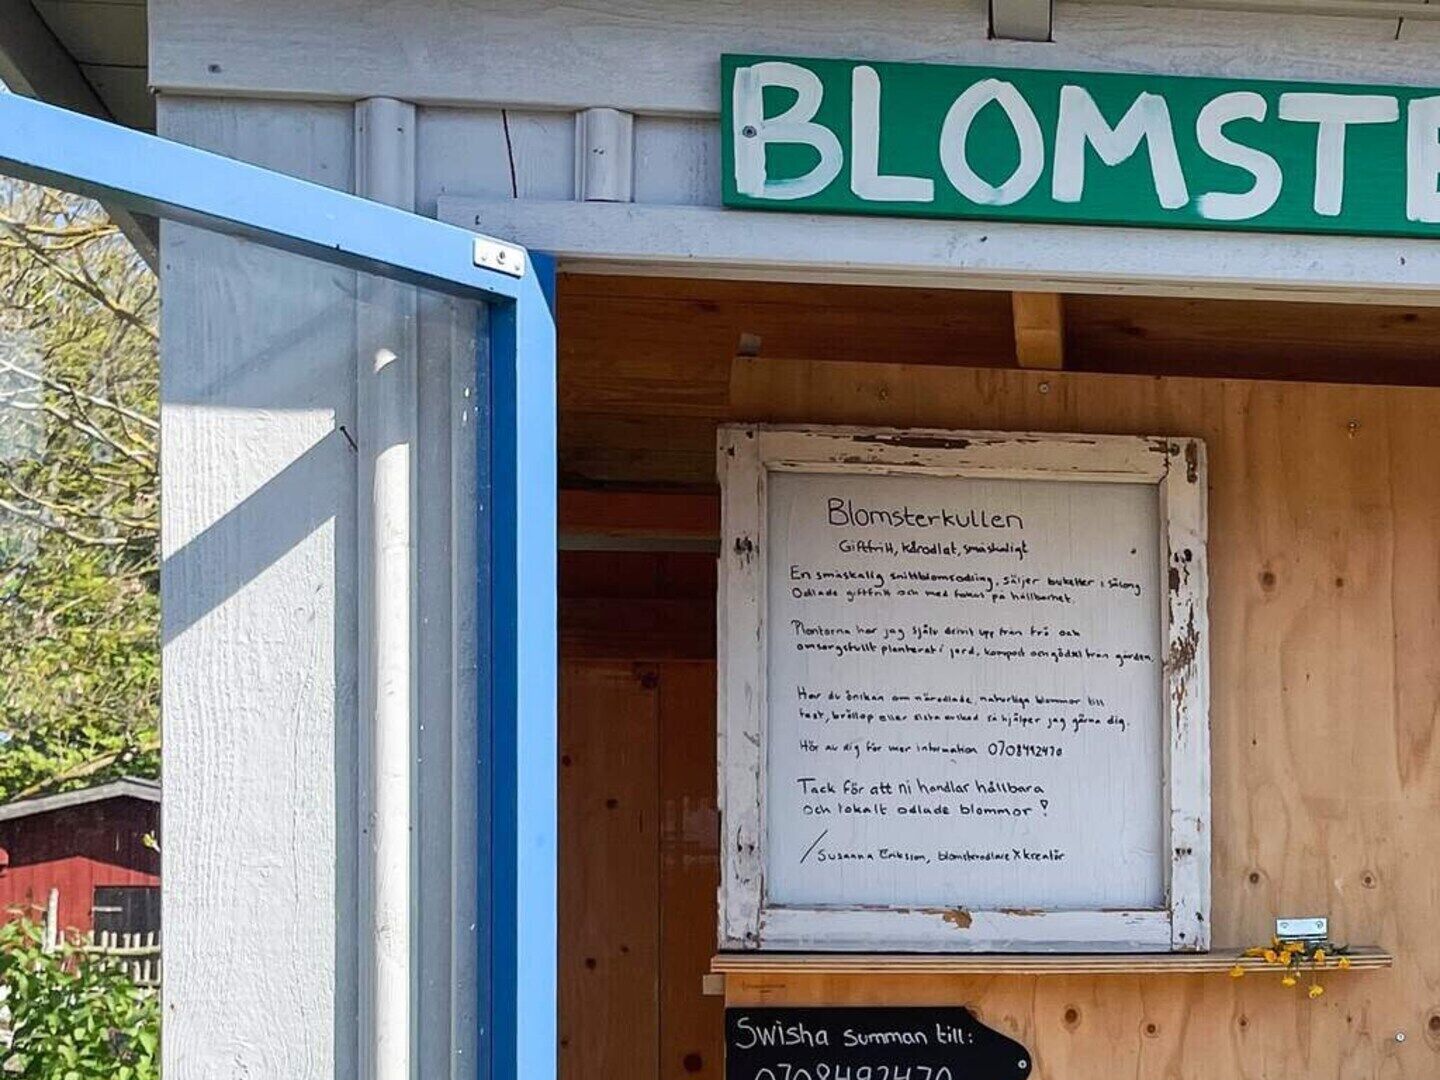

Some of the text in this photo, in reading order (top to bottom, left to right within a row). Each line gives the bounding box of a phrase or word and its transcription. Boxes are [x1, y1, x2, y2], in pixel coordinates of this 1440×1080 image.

[827, 497, 1024, 530] Blomsterkullen
[790, 565, 812, 581] En
[791, 587, 838, 599] Odlade
[992, 590, 1006, 603] på
[791, 619, 852, 635] Plantorna
[856, 625, 878, 635] har
[885, 627, 905, 640] jag
[912, 624, 939, 639] själv
[979, 629, 995, 639] upp
[1058, 629, 1081, 637] och
[881, 644, 936, 656] planterat
[797, 685, 823, 701] Har
[828, 690, 841, 701] du
[845, 689, 886, 702] önskan
[879, 713, 908, 723] eller
[1001, 712, 1042, 728] hjälper
[1047, 716, 1067, 732] jag
[1072, 713, 1102, 733] gärna
[799, 740, 820, 752] Hör
[825, 744, 838, 752] av
[843, 742, 861, 759] dig
[888, 744, 911, 752] mer
[796, 778, 1045, 796] Tack för att ni handlar hållbara
[838, 802, 888, 816] lokalt
[897, 803, 950, 815] odlade
[959, 803, 1033, 817] blommor
[736, 1016, 975, 1049] Swisha summan till:
